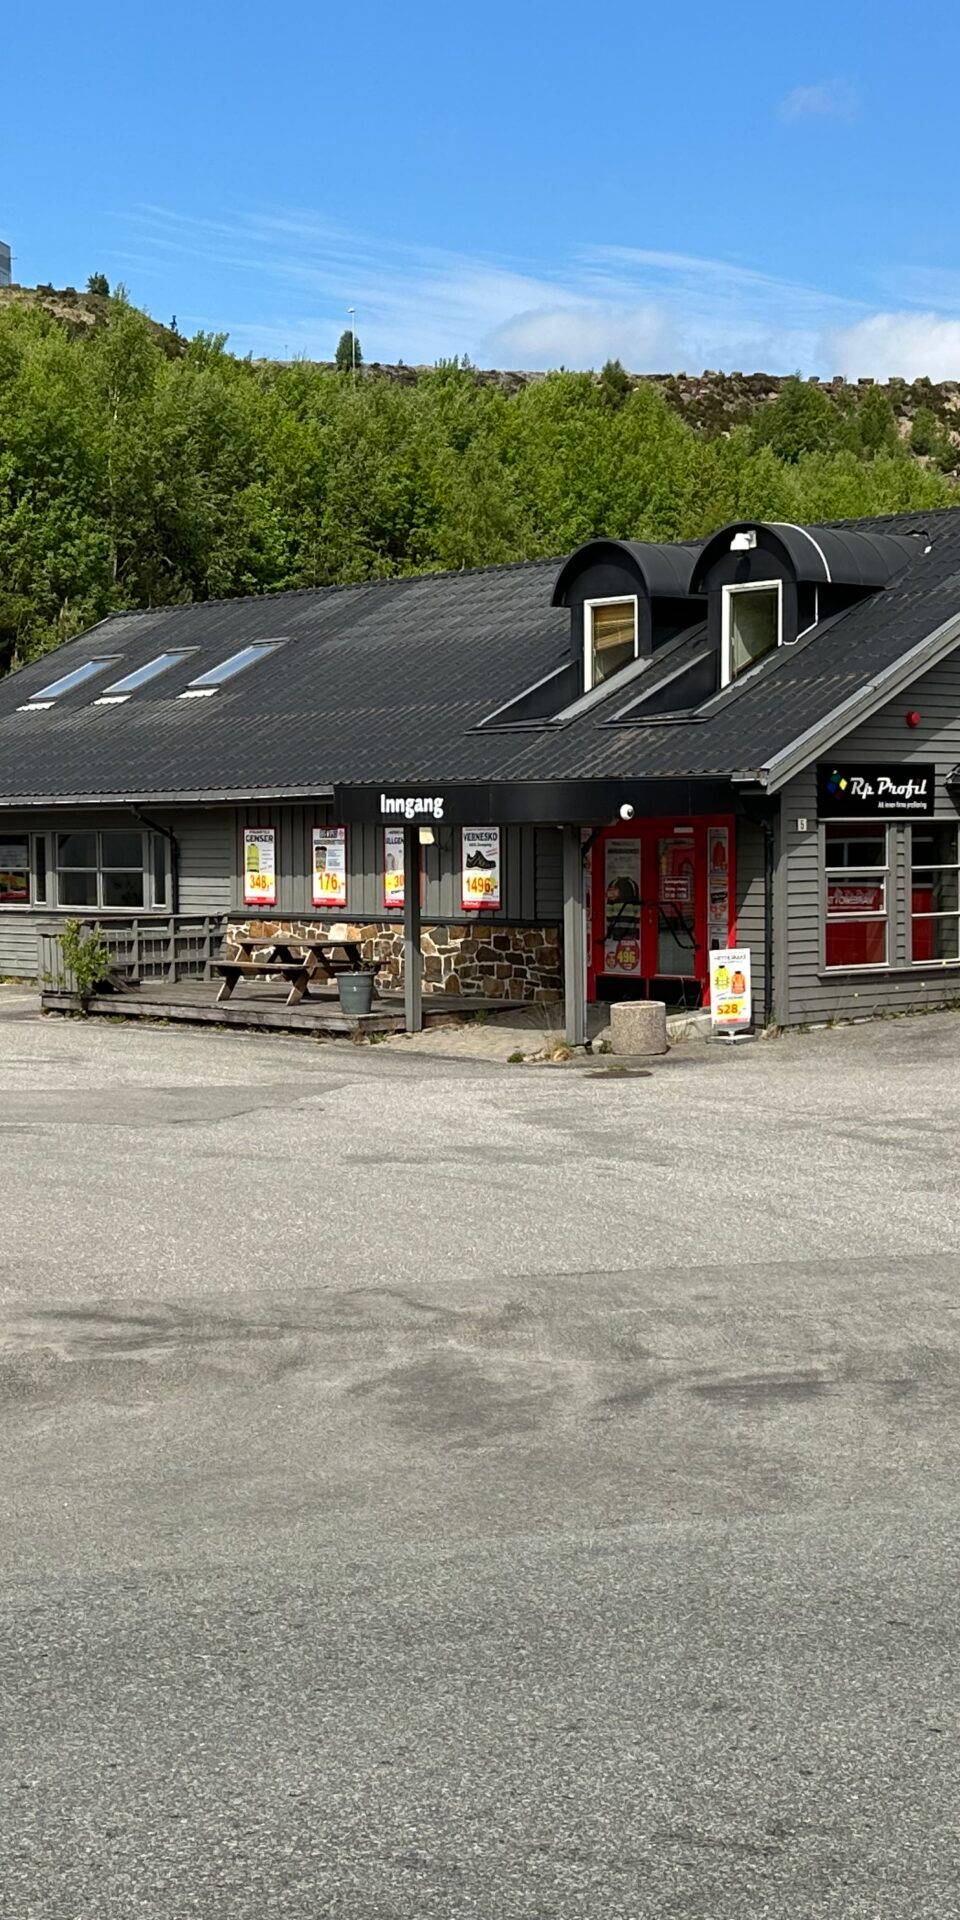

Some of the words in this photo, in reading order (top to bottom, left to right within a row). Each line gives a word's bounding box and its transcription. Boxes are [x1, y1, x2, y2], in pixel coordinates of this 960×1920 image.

[876, 776, 927, 799] Profil
[380, 793, 444, 819] Inngang
[246, 834, 273, 843] GENSER
